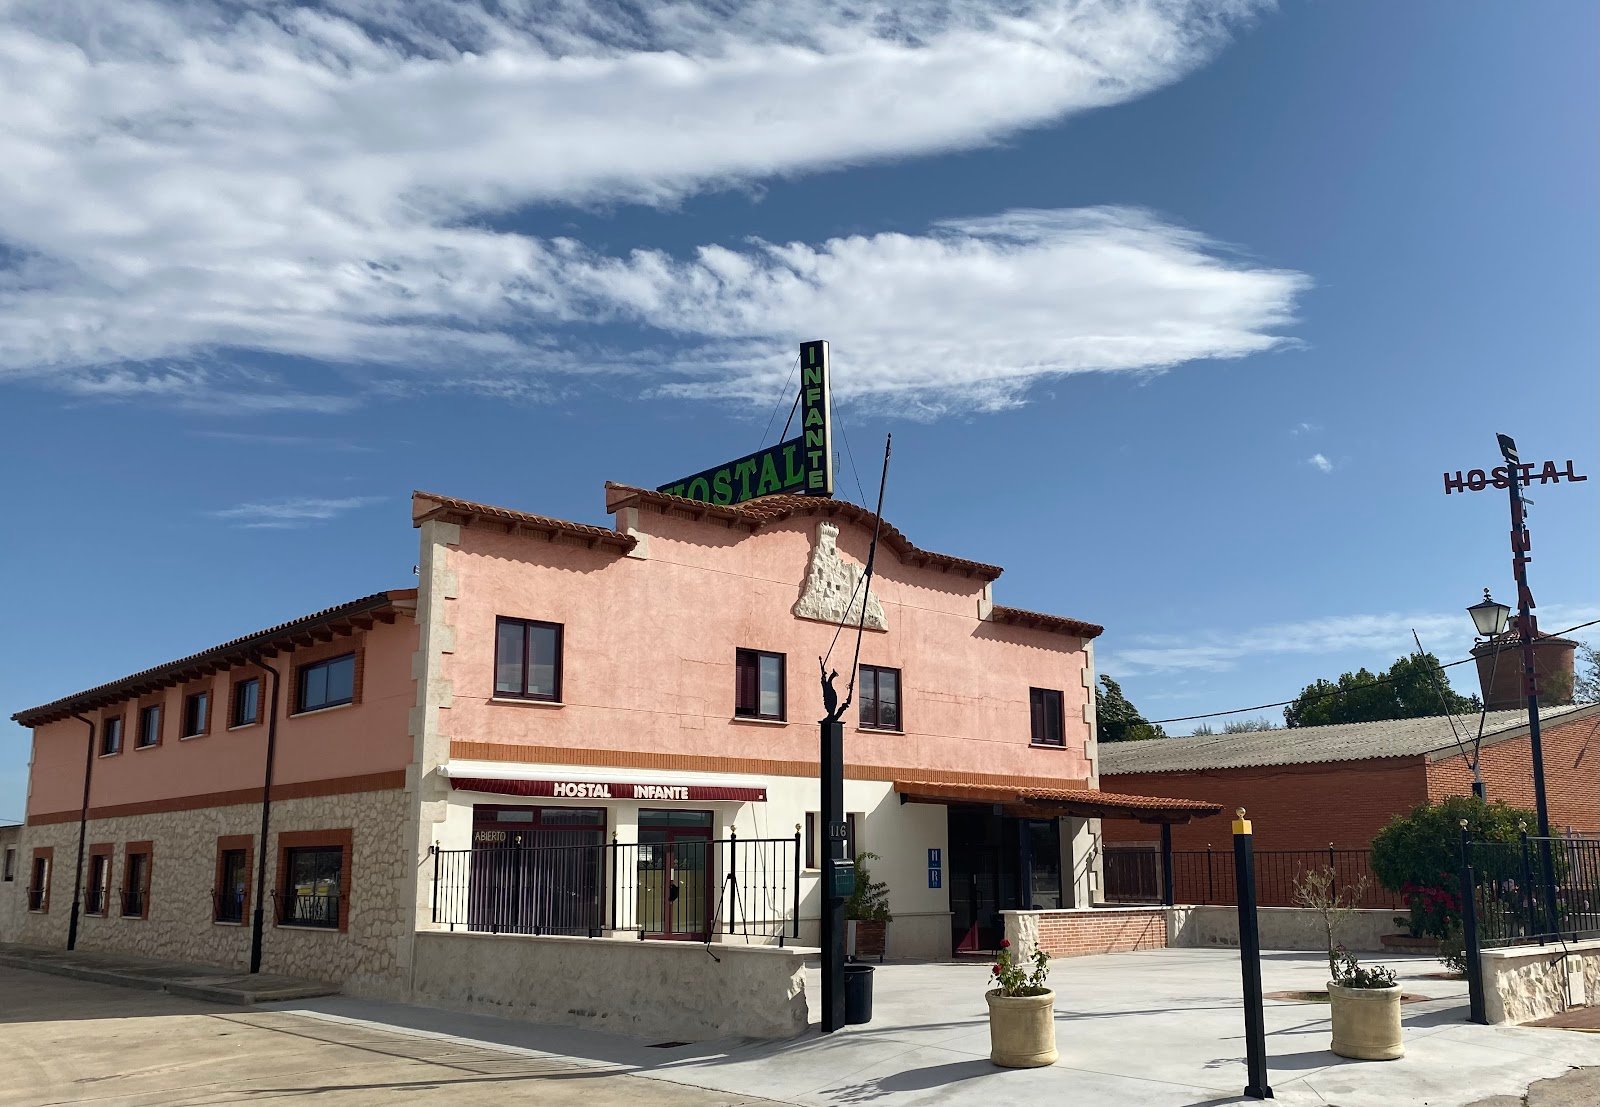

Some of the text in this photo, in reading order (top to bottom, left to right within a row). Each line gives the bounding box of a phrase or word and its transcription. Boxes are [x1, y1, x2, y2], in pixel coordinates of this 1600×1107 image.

[803, 346, 824, 489] INFANTE
[1444, 460, 1588, 494] HOSTAL
[553, 782, 689, 800] HOSTAL INFANTE
[474, 830, 506, 842] ABIERTO
[830, 825, 847, 837] 116
